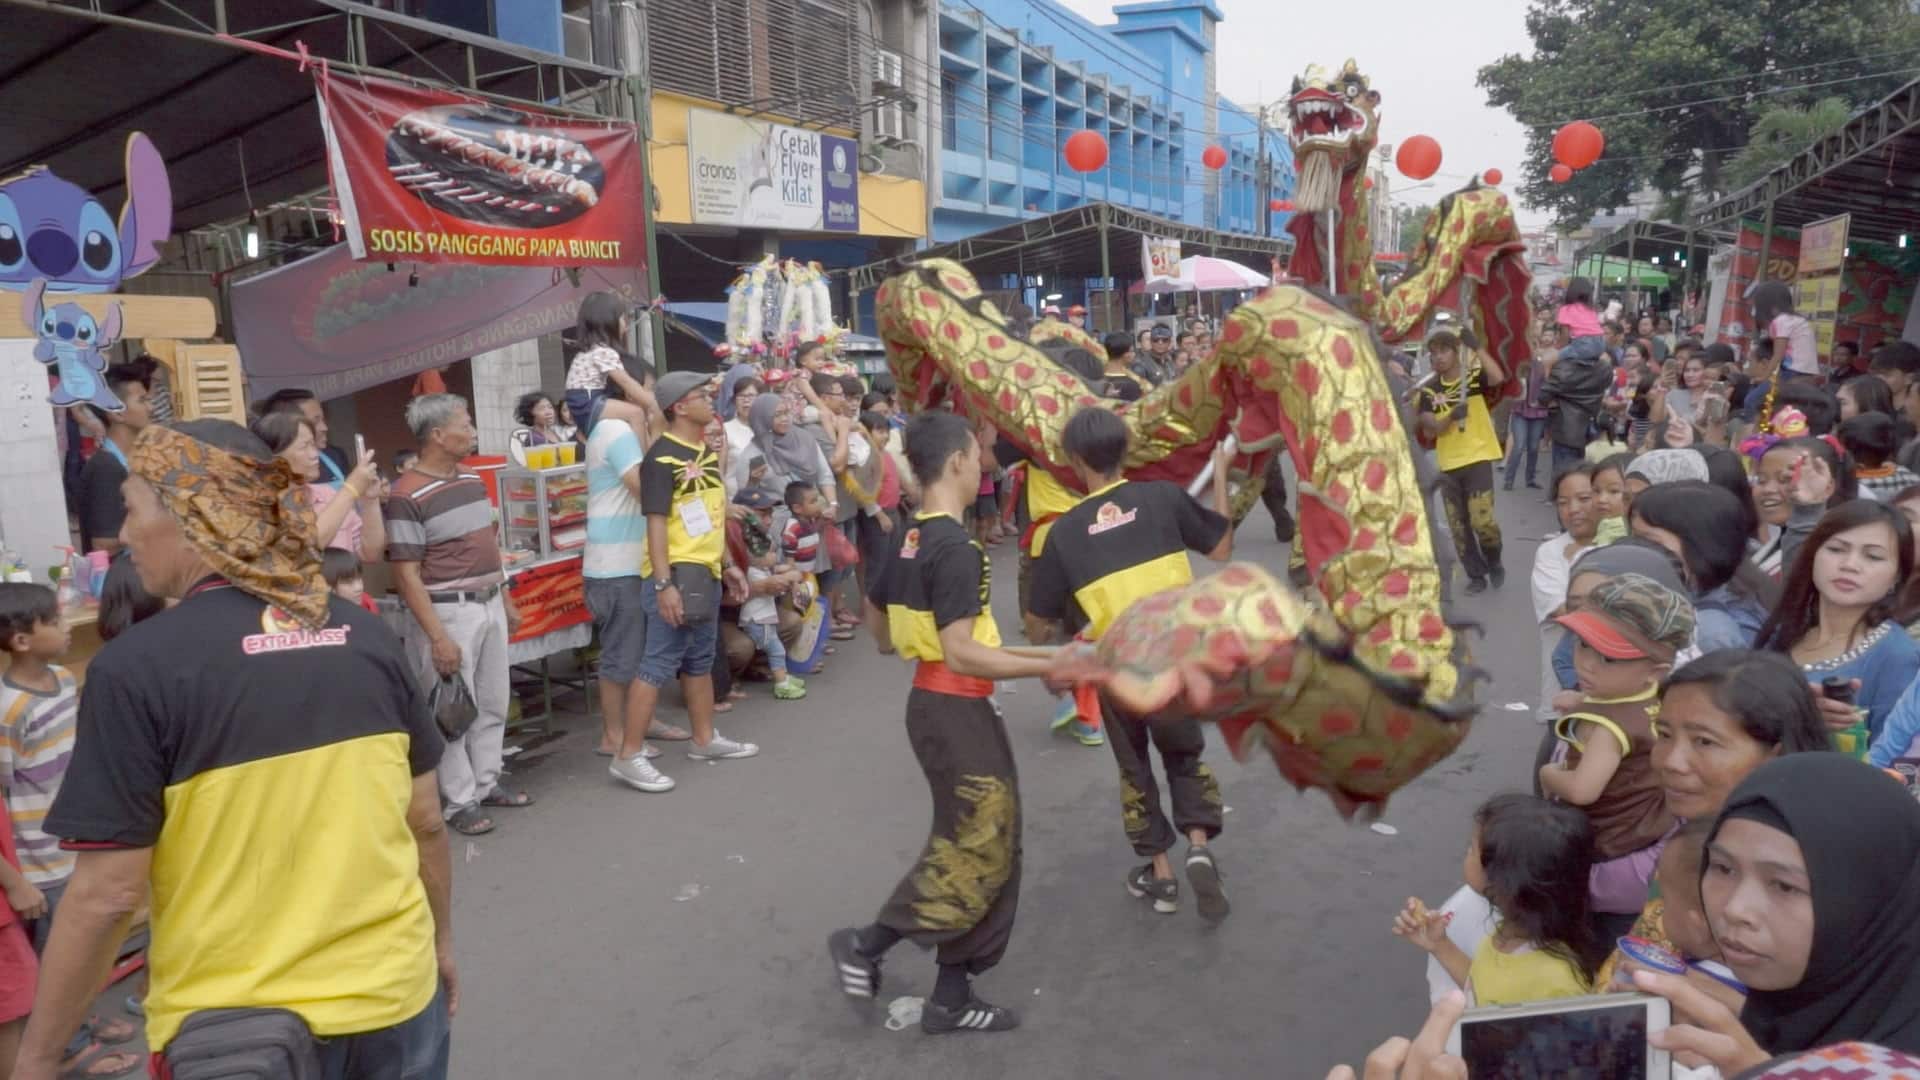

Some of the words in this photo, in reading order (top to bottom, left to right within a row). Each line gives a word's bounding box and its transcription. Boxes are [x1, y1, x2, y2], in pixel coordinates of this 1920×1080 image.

[780, 130, 818, 157] Cetak
[699, 162, 736, 181] cronos
[781, 153, 814, 184] Flyer
[782, 179, 813, 204] Kilat
[370, 228, 424, 253] SOSIS
[427, 231, 526, 257] PANGGANG
[529, 238, 567, 258] PAPA
[568, 239, 621, 260] BUNCIT
